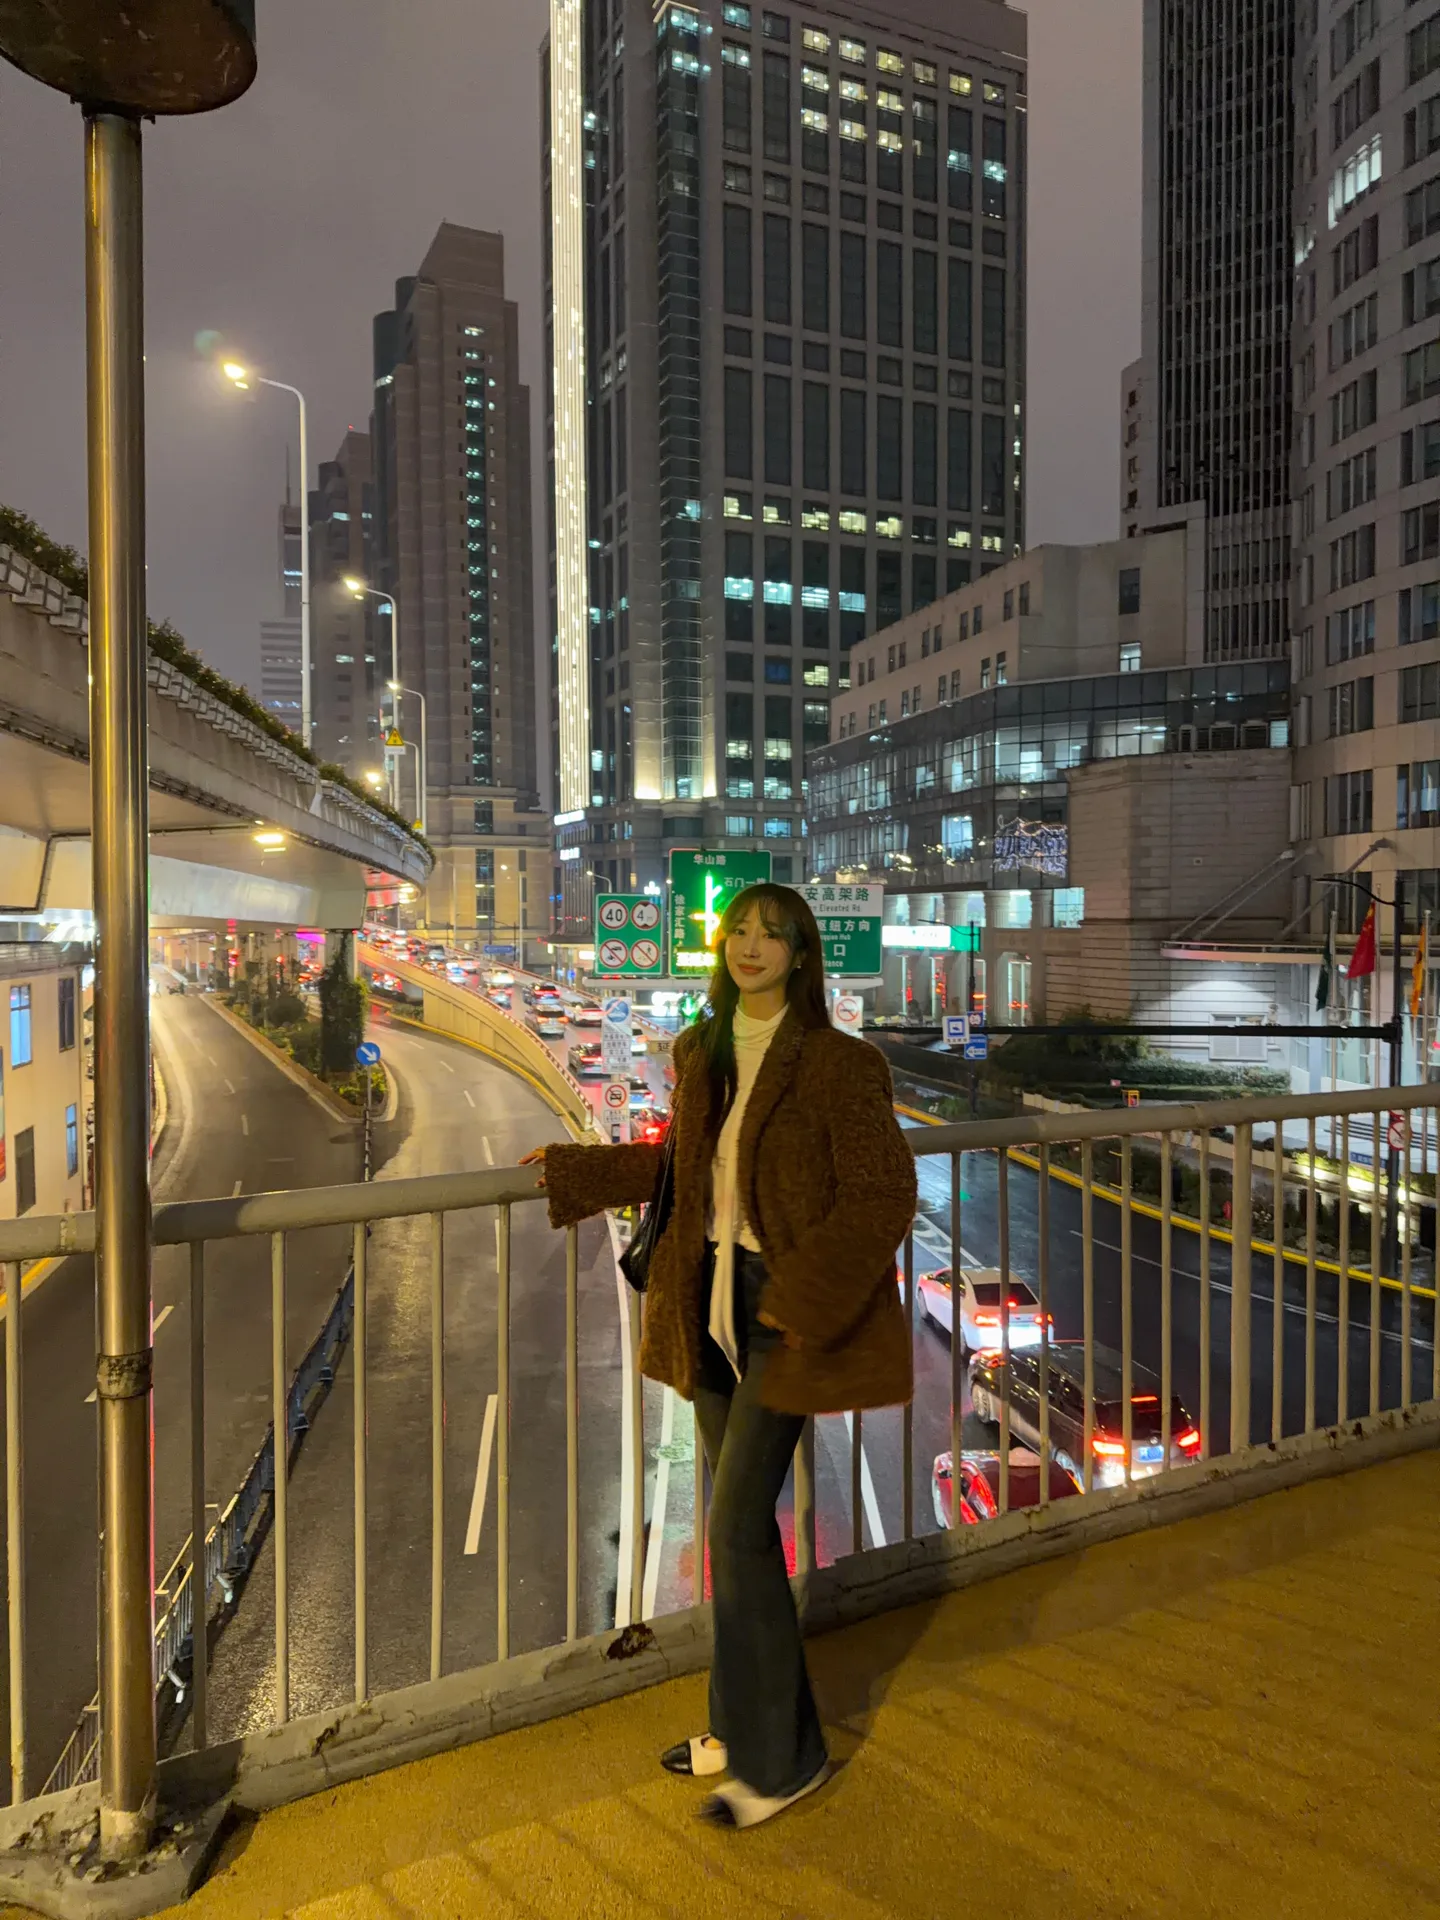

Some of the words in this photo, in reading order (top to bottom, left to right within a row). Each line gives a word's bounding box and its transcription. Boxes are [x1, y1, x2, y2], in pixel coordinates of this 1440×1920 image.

[693, 854, 726, 865] 华山路
[794, 887, 869, 901] 安高架路
[606, 909, 623, 921] 40
